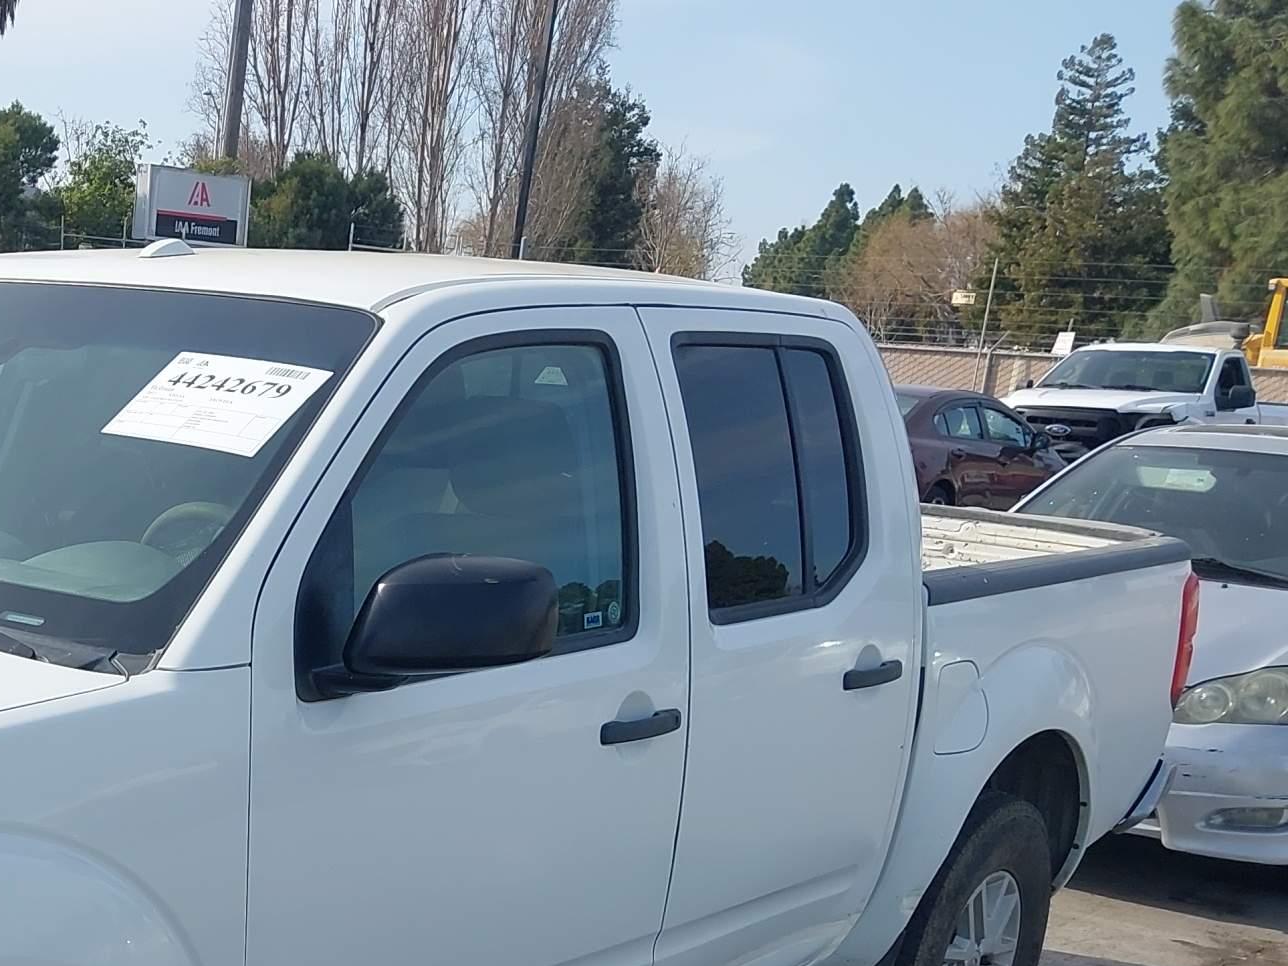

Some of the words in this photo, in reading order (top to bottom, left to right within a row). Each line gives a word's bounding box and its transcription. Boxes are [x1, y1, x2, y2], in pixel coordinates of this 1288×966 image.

[174, 220, 190, 234] IAA
[191, 222, 220, 237] Fremont
[168, 371, 292, 399] 44242679
